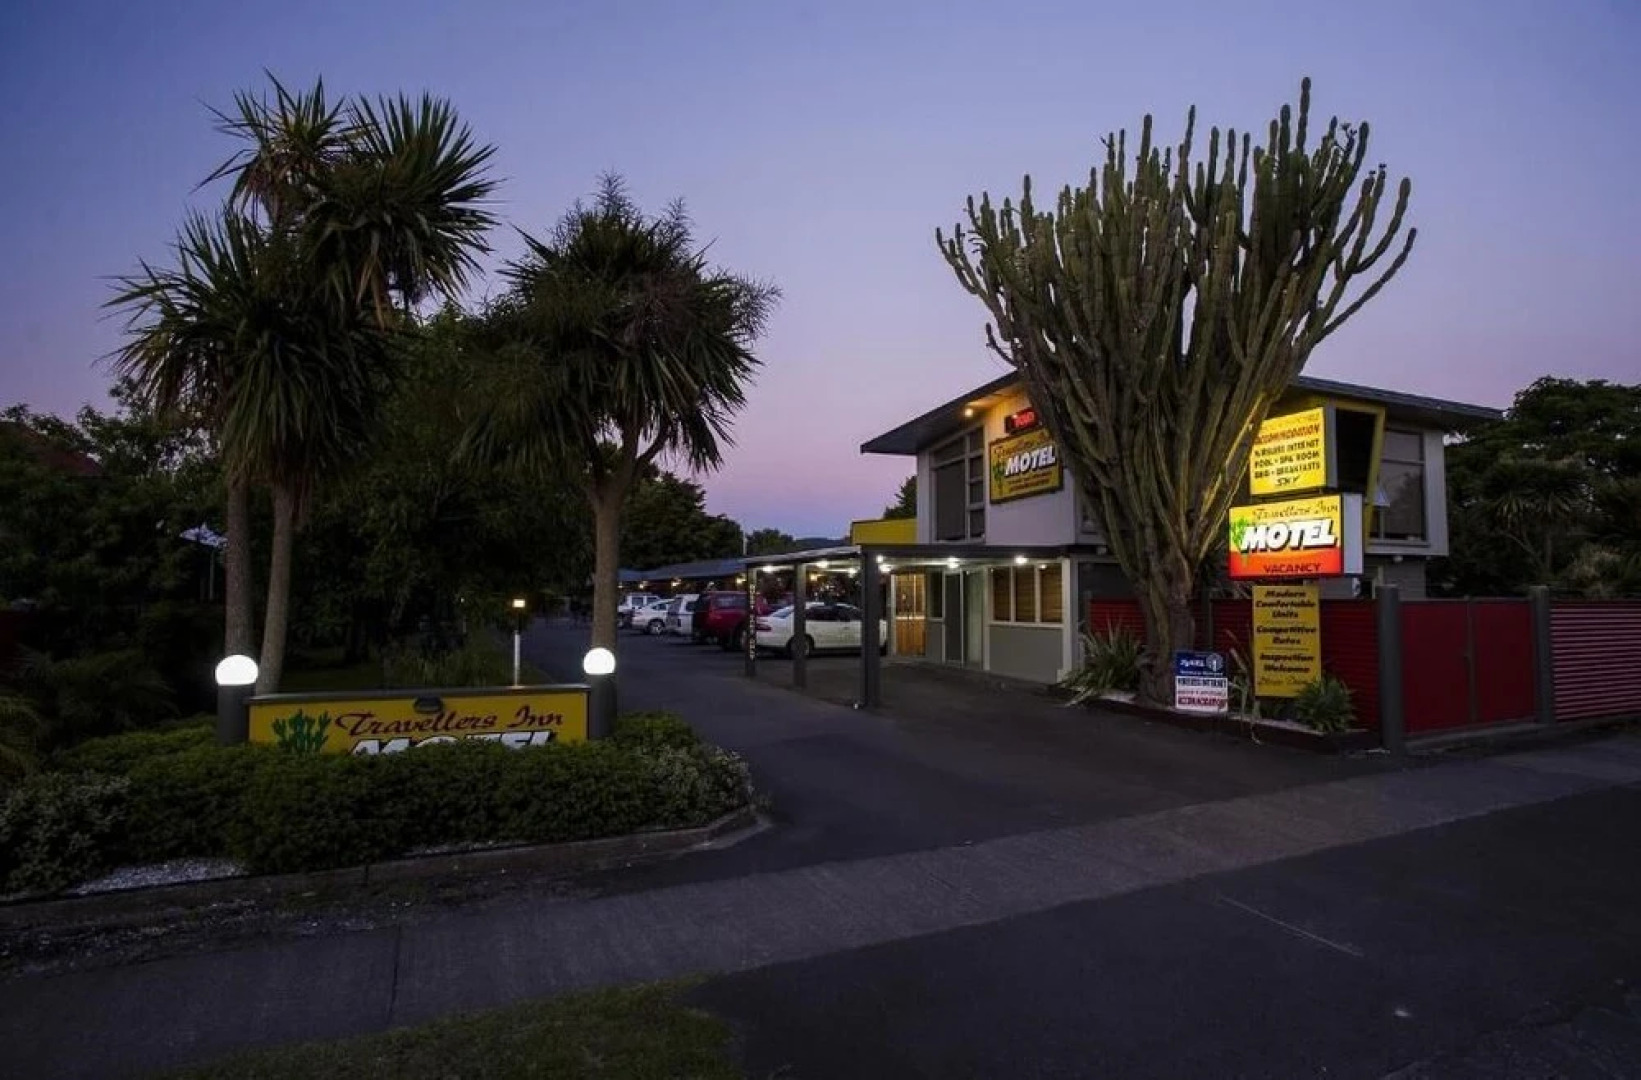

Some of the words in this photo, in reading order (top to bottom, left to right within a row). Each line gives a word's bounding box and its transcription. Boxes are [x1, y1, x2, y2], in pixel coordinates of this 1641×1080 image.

[1005, 446, 1057, 477] MOTEL
[1255, 459, 1273, 469] POOL
[1296, 450, 1320, 461] ROOM
[1239, 518, 1337, 553] MOTEL
[1263, 562, 1322, 574] VACANCY
[1265, 590, 1307, 598] Modern
[1272, 610, 1299, 618] Units
[335, 710, 498, 736] Travellers
[506, 704, 565, 728] Inn
